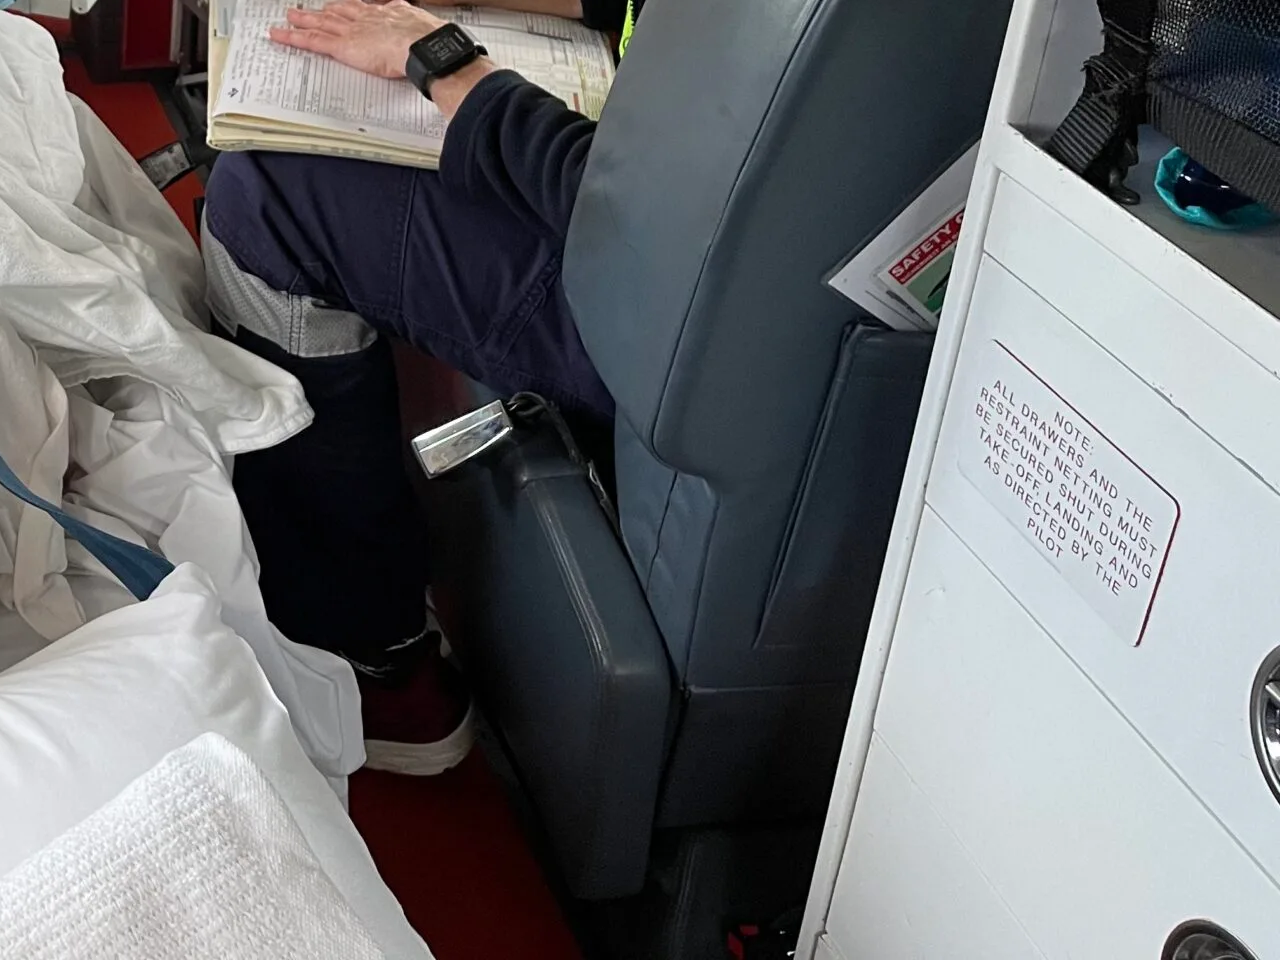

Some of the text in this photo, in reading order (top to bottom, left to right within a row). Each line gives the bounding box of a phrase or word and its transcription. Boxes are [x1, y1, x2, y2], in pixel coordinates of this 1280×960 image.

[891, 225, 952, 277] SAFETY
[975, 404, 1152, 579] BE SECURED SHUT DURING
[980, 387, 1158, 558] RESTRAINT NETTING MUST
[993, 380, 1152, 532] ALL DRAWERS AND THE
[1054, 412, 1095, 455] NOTE:
[979, 427, 1138, 589] TAKE-OFF, LANDING AND
[984, 455, 1121, 596] AS DIRECTED BY THE
[1027, 519, 1064, 558] PILOT
